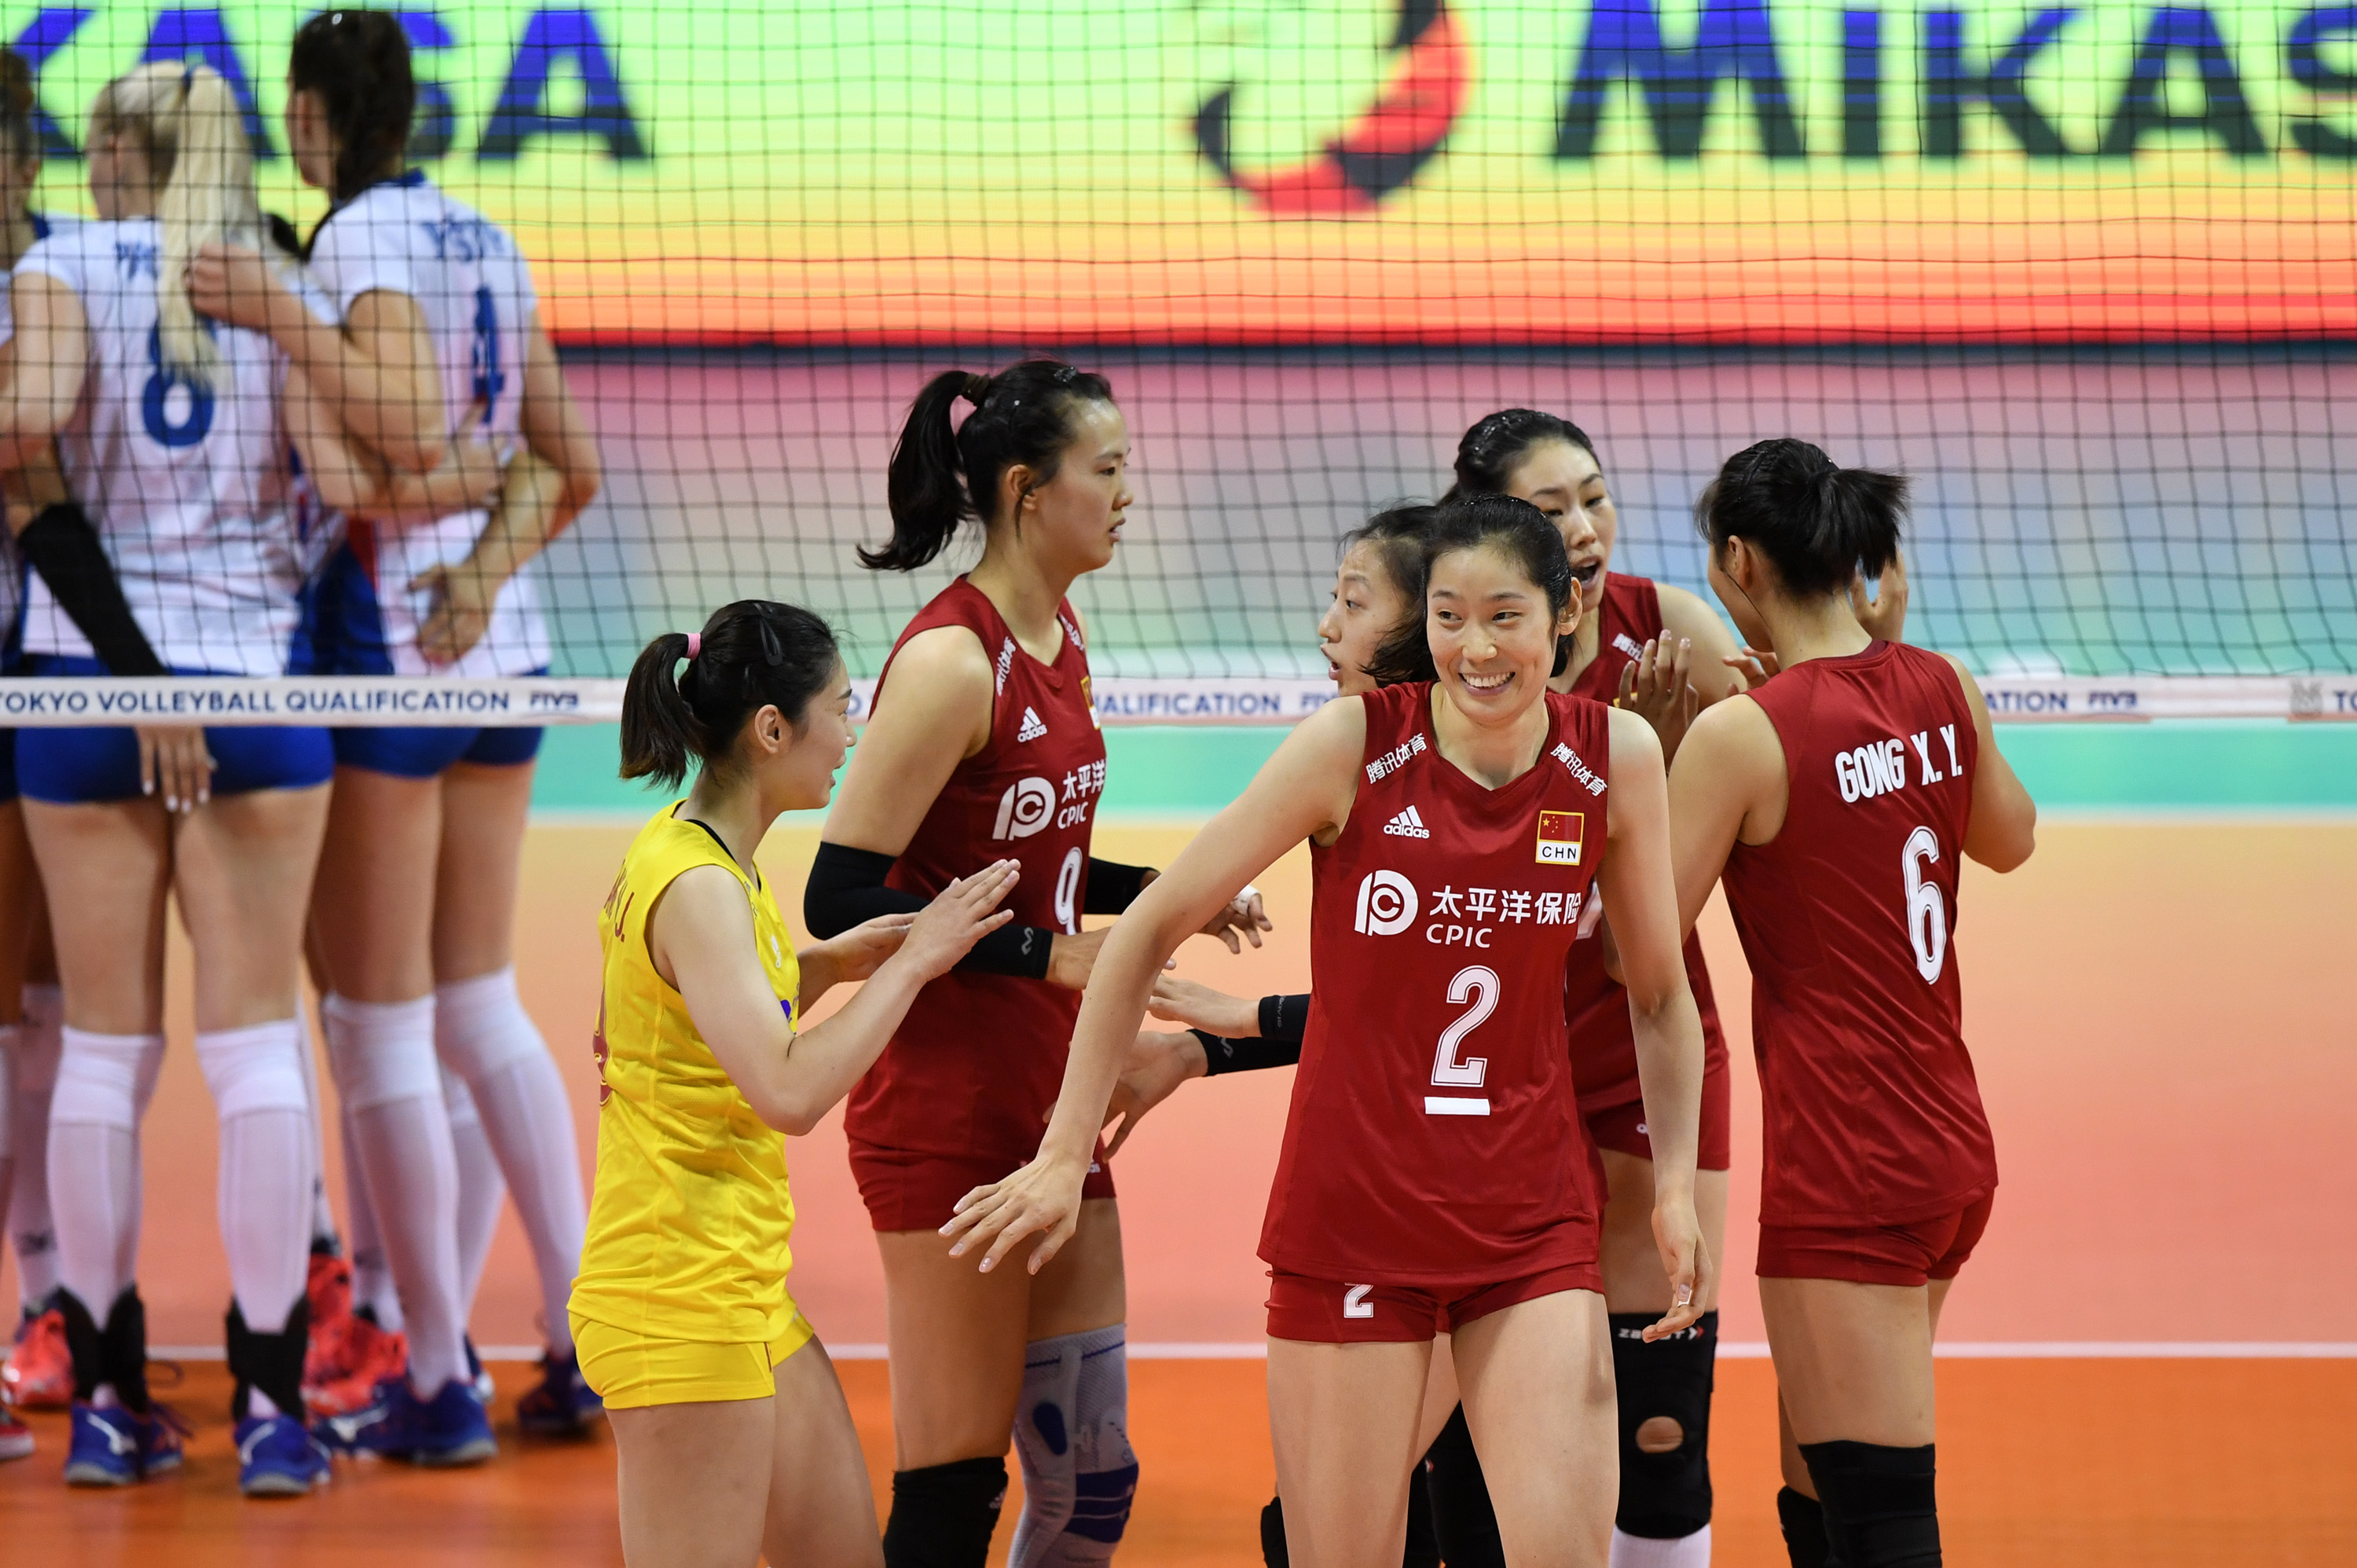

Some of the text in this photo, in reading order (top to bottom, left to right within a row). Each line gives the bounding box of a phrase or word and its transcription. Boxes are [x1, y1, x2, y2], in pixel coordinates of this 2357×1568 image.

[0, 691, 89, 713] OKYO
[96, 690, 276, 713] VOLLEYBALL
[284, 689, 510, 712] QUALIFICATION
[1365, 732, 1428, 785] 腾讯体育
[1549, 742, 1608, 797] 腾讯体育
[1835, 724, 1963, 803] GONG X. Y.
[1057, 801, 1089, 830] CPIC
[1383, 822, 1430, 839] adidas
[1541, 845, 1577, 859] CHN
[1054, 846, 1083, 936] 9
[1428, 885, 1582, 925] 太平洋保险
[1901, 825, 1947, 985] 6
[1425, 923, 1493, 949] CPIC
[1430, 964, 1501, 1088] 2
[1343, 1281, 1374, 1319] 2
